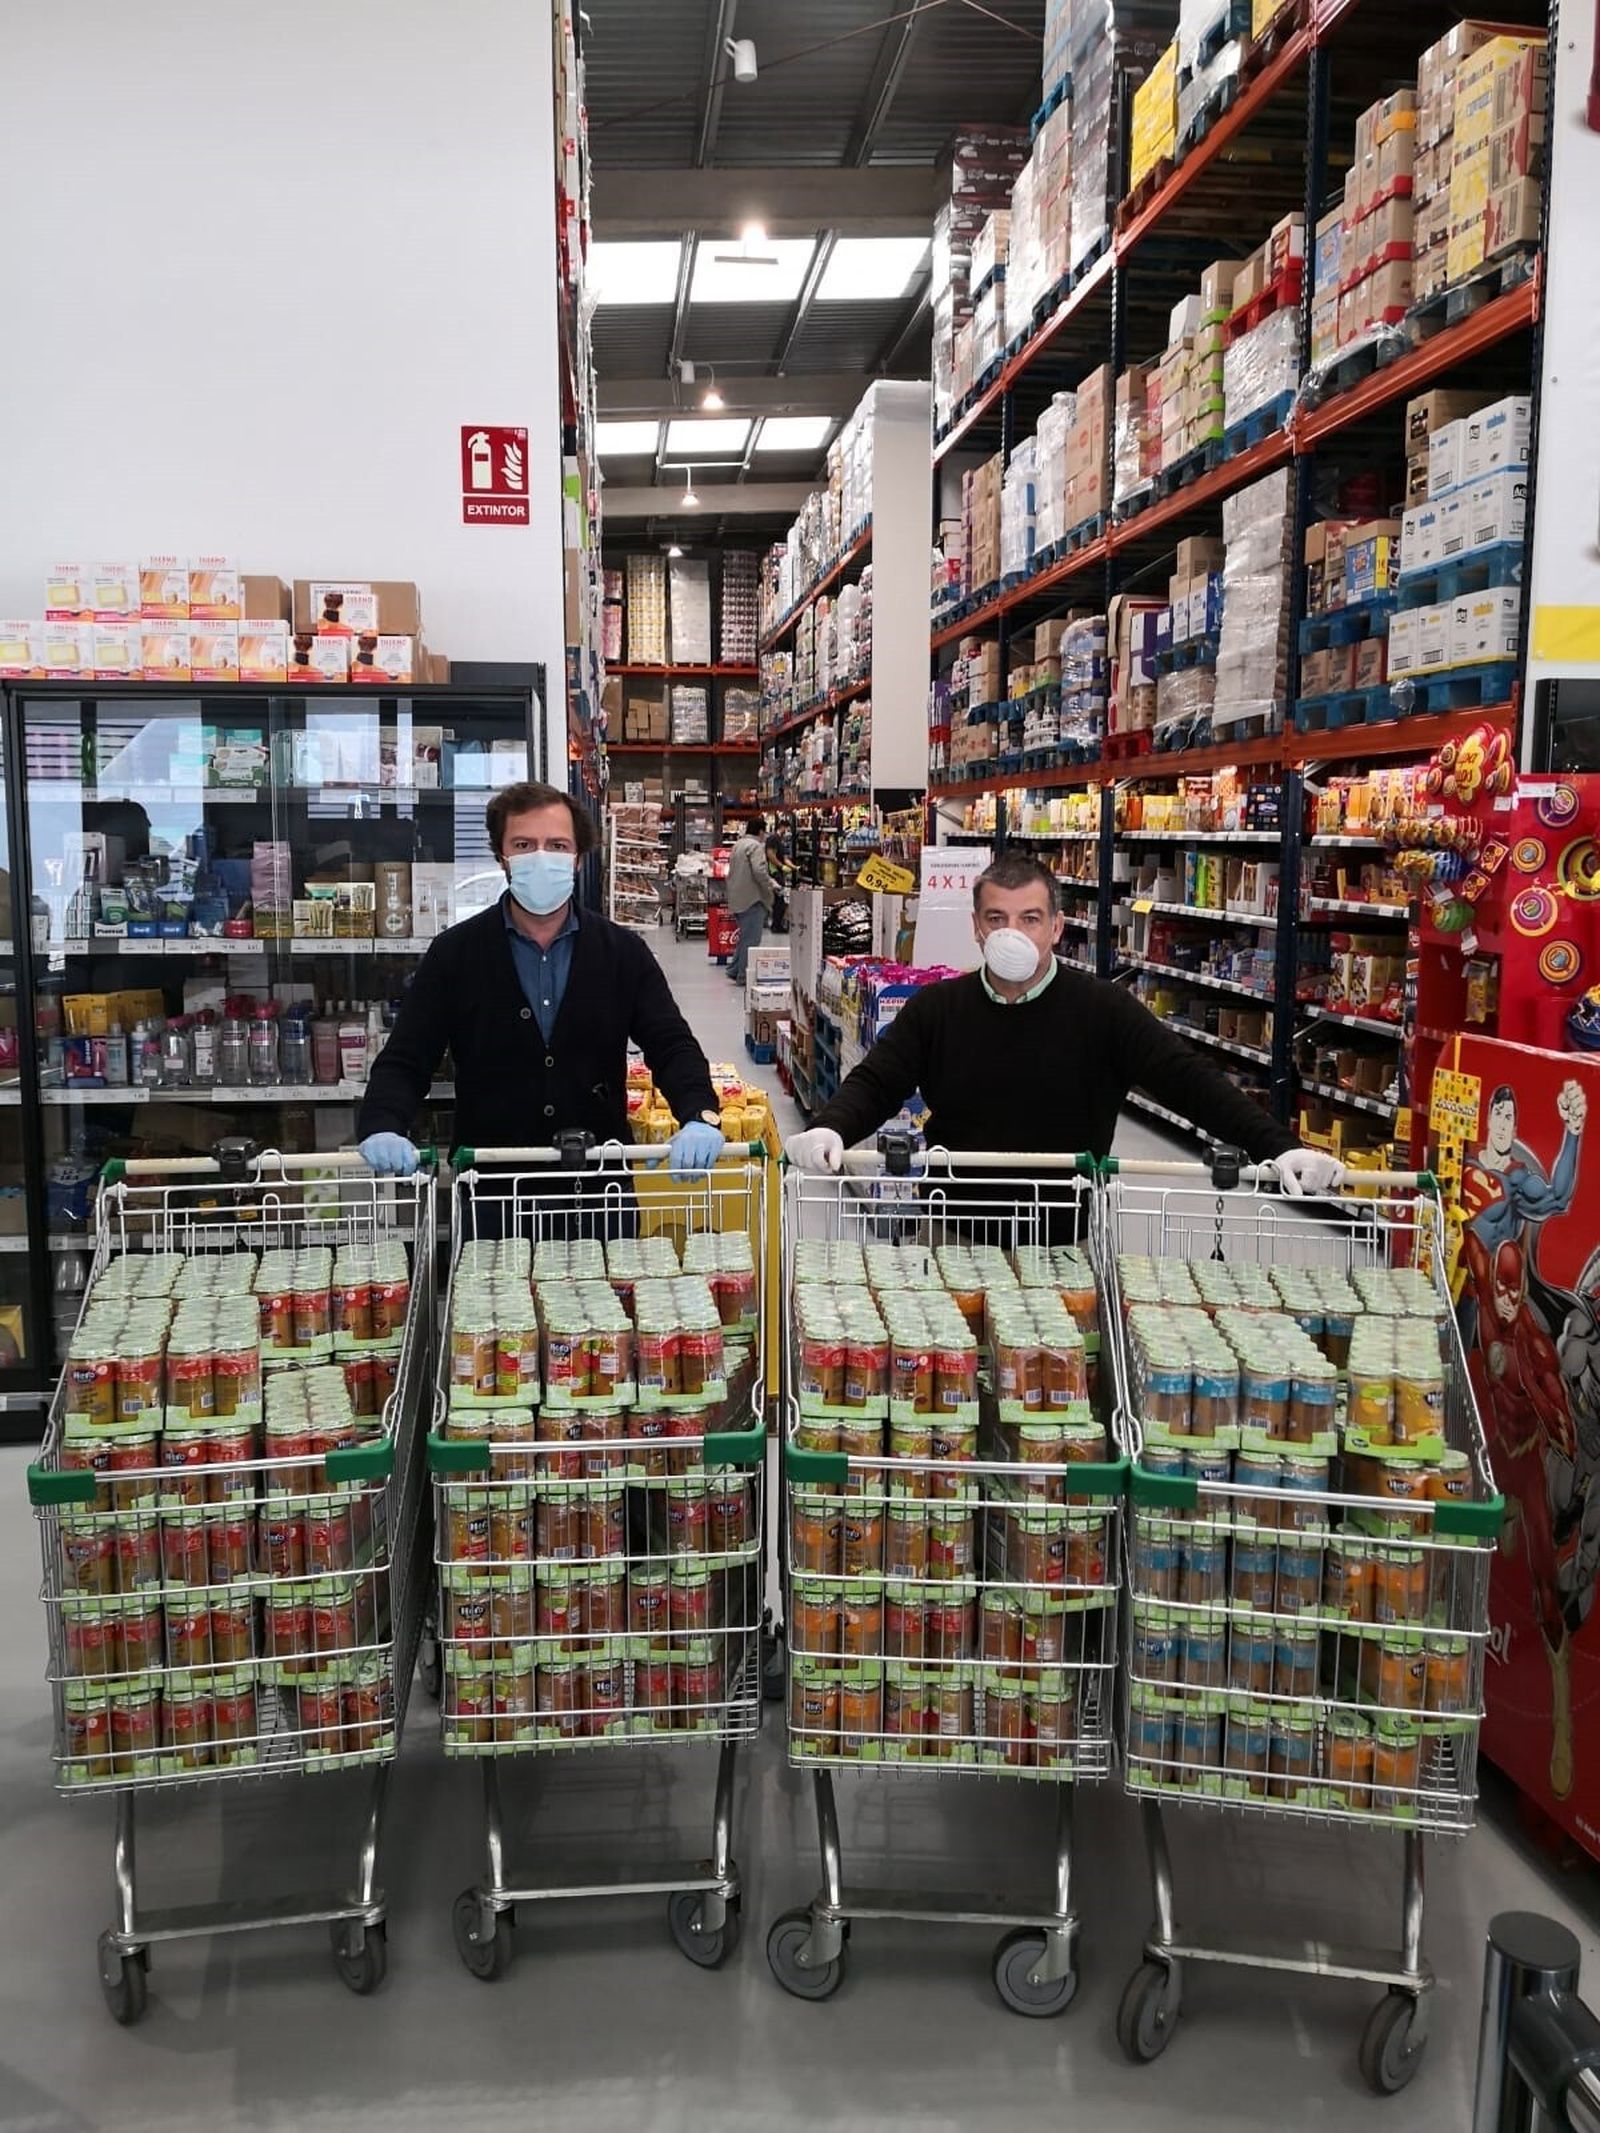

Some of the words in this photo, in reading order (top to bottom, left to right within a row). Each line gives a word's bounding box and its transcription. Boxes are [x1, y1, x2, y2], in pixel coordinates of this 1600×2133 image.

[467, 505, 526, 517] EXTINTOR
[928, 875, 937, 888] 4
[943, 875, 953, 888] X
[73, 1371, 95, 1381] Hero
